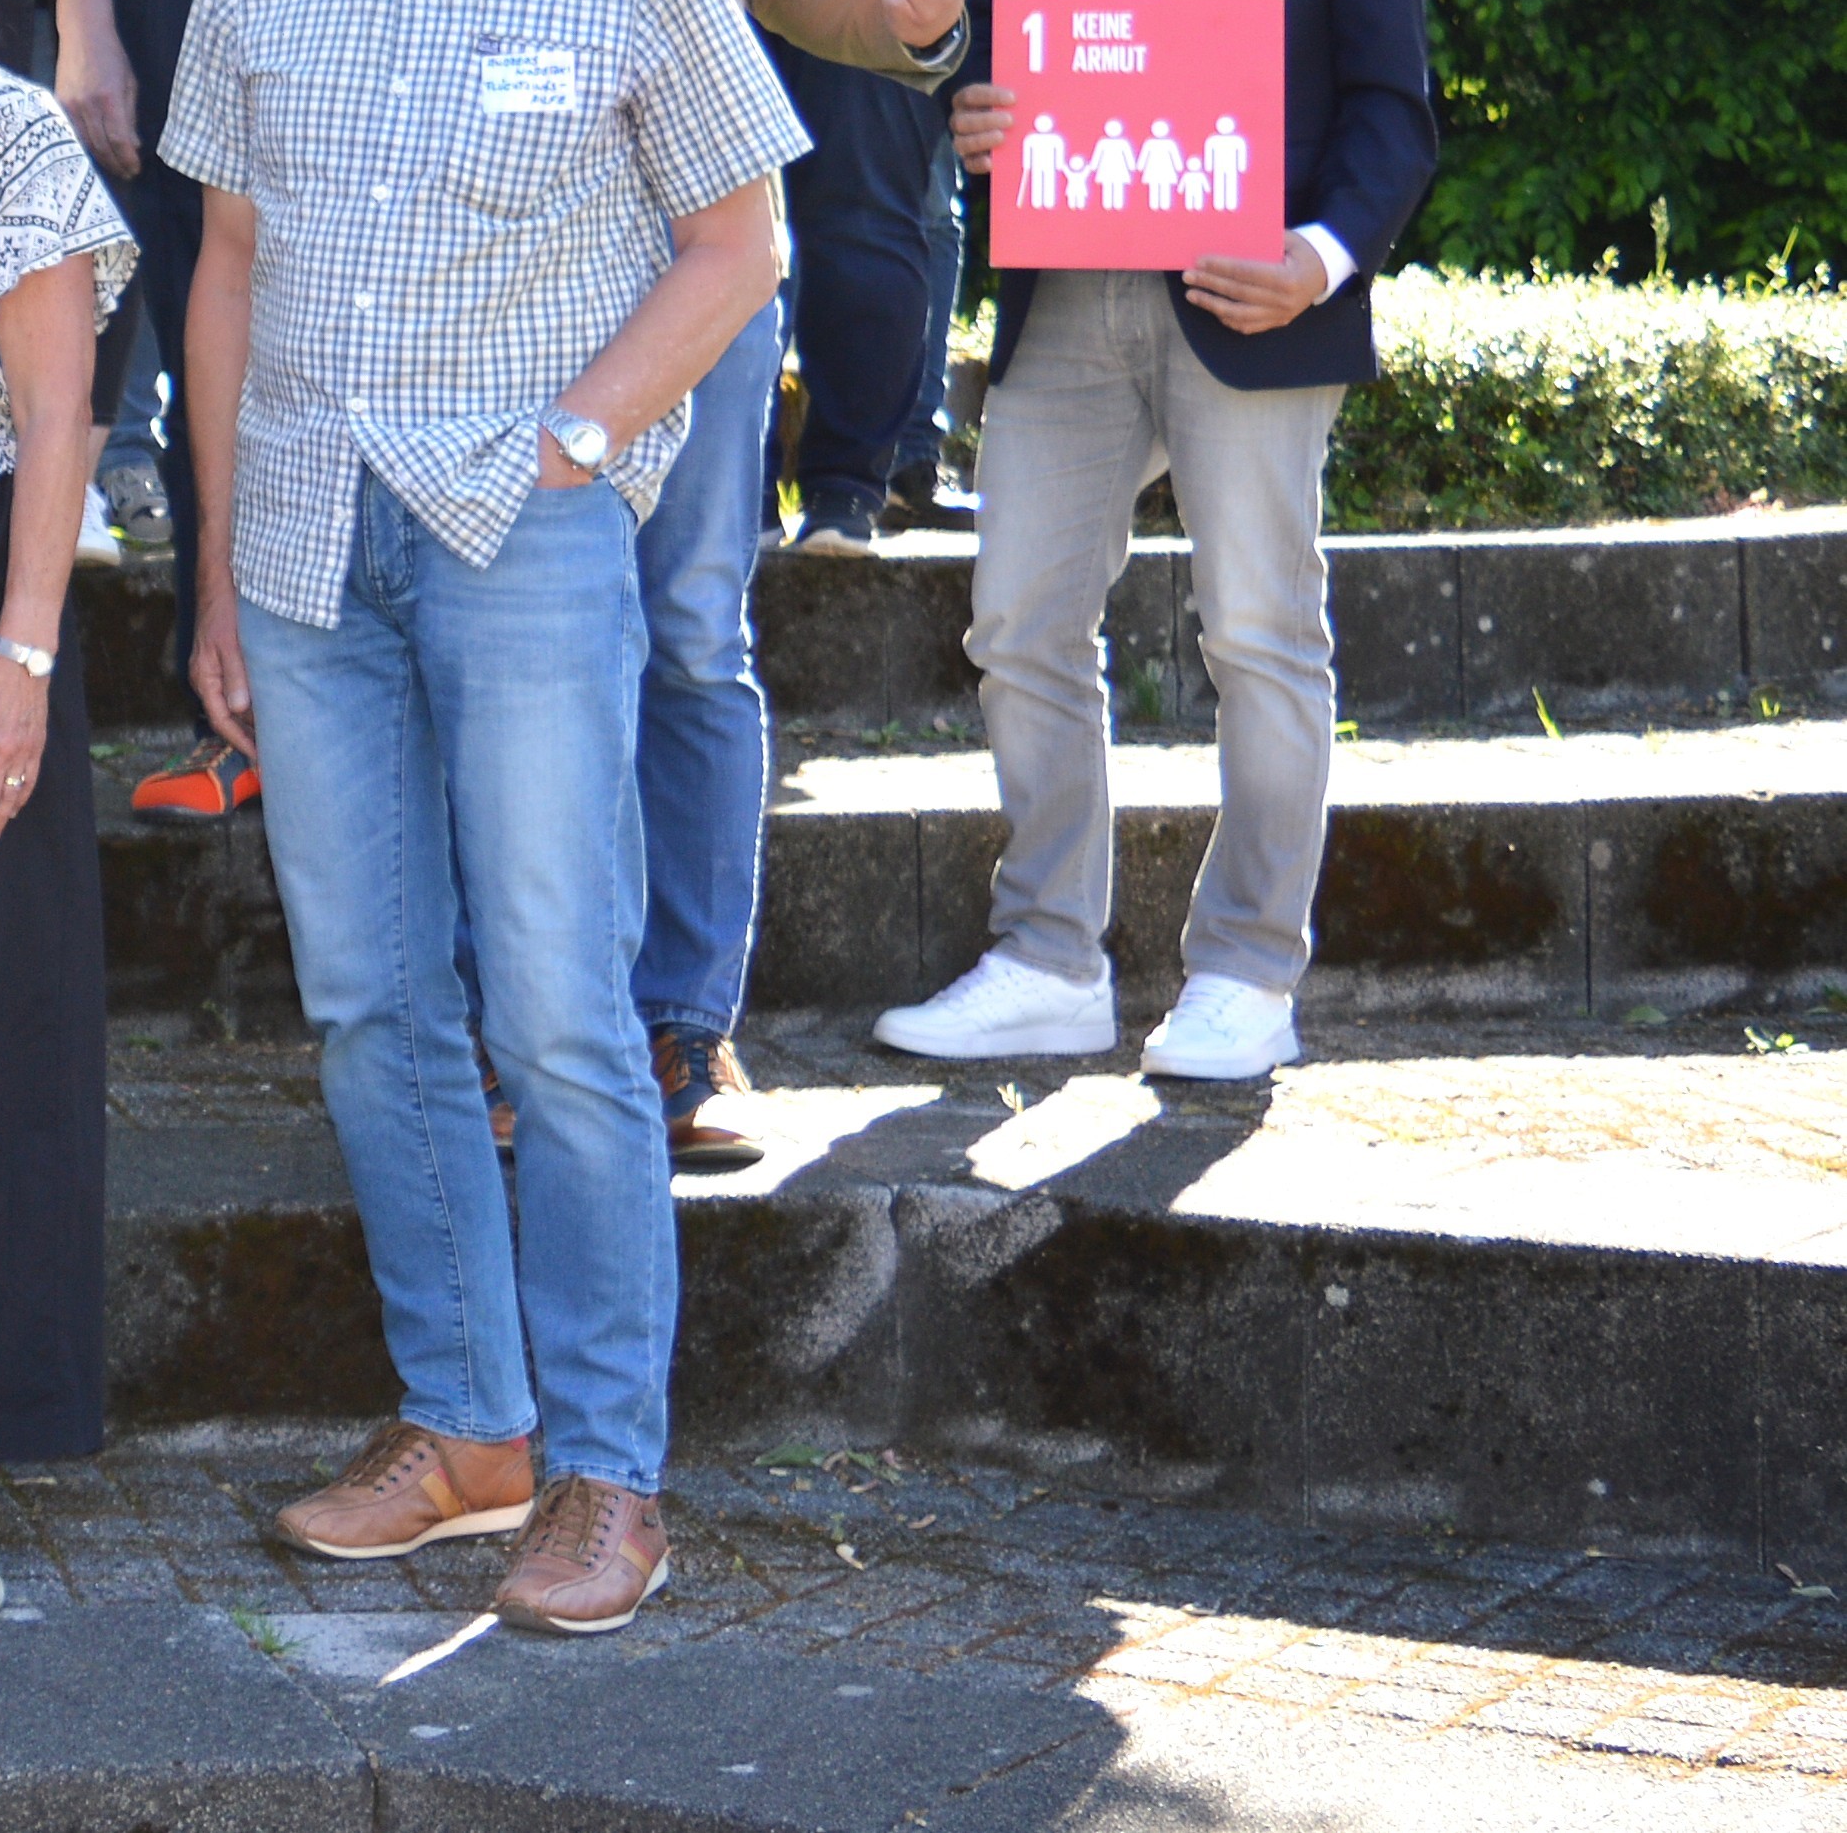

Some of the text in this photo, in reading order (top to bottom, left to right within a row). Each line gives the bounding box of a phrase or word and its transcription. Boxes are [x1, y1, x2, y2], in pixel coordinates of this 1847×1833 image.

[1022, 12, 1132, 73] 1 KEINE
[1072, 45, 1147, 73] ARMUT
